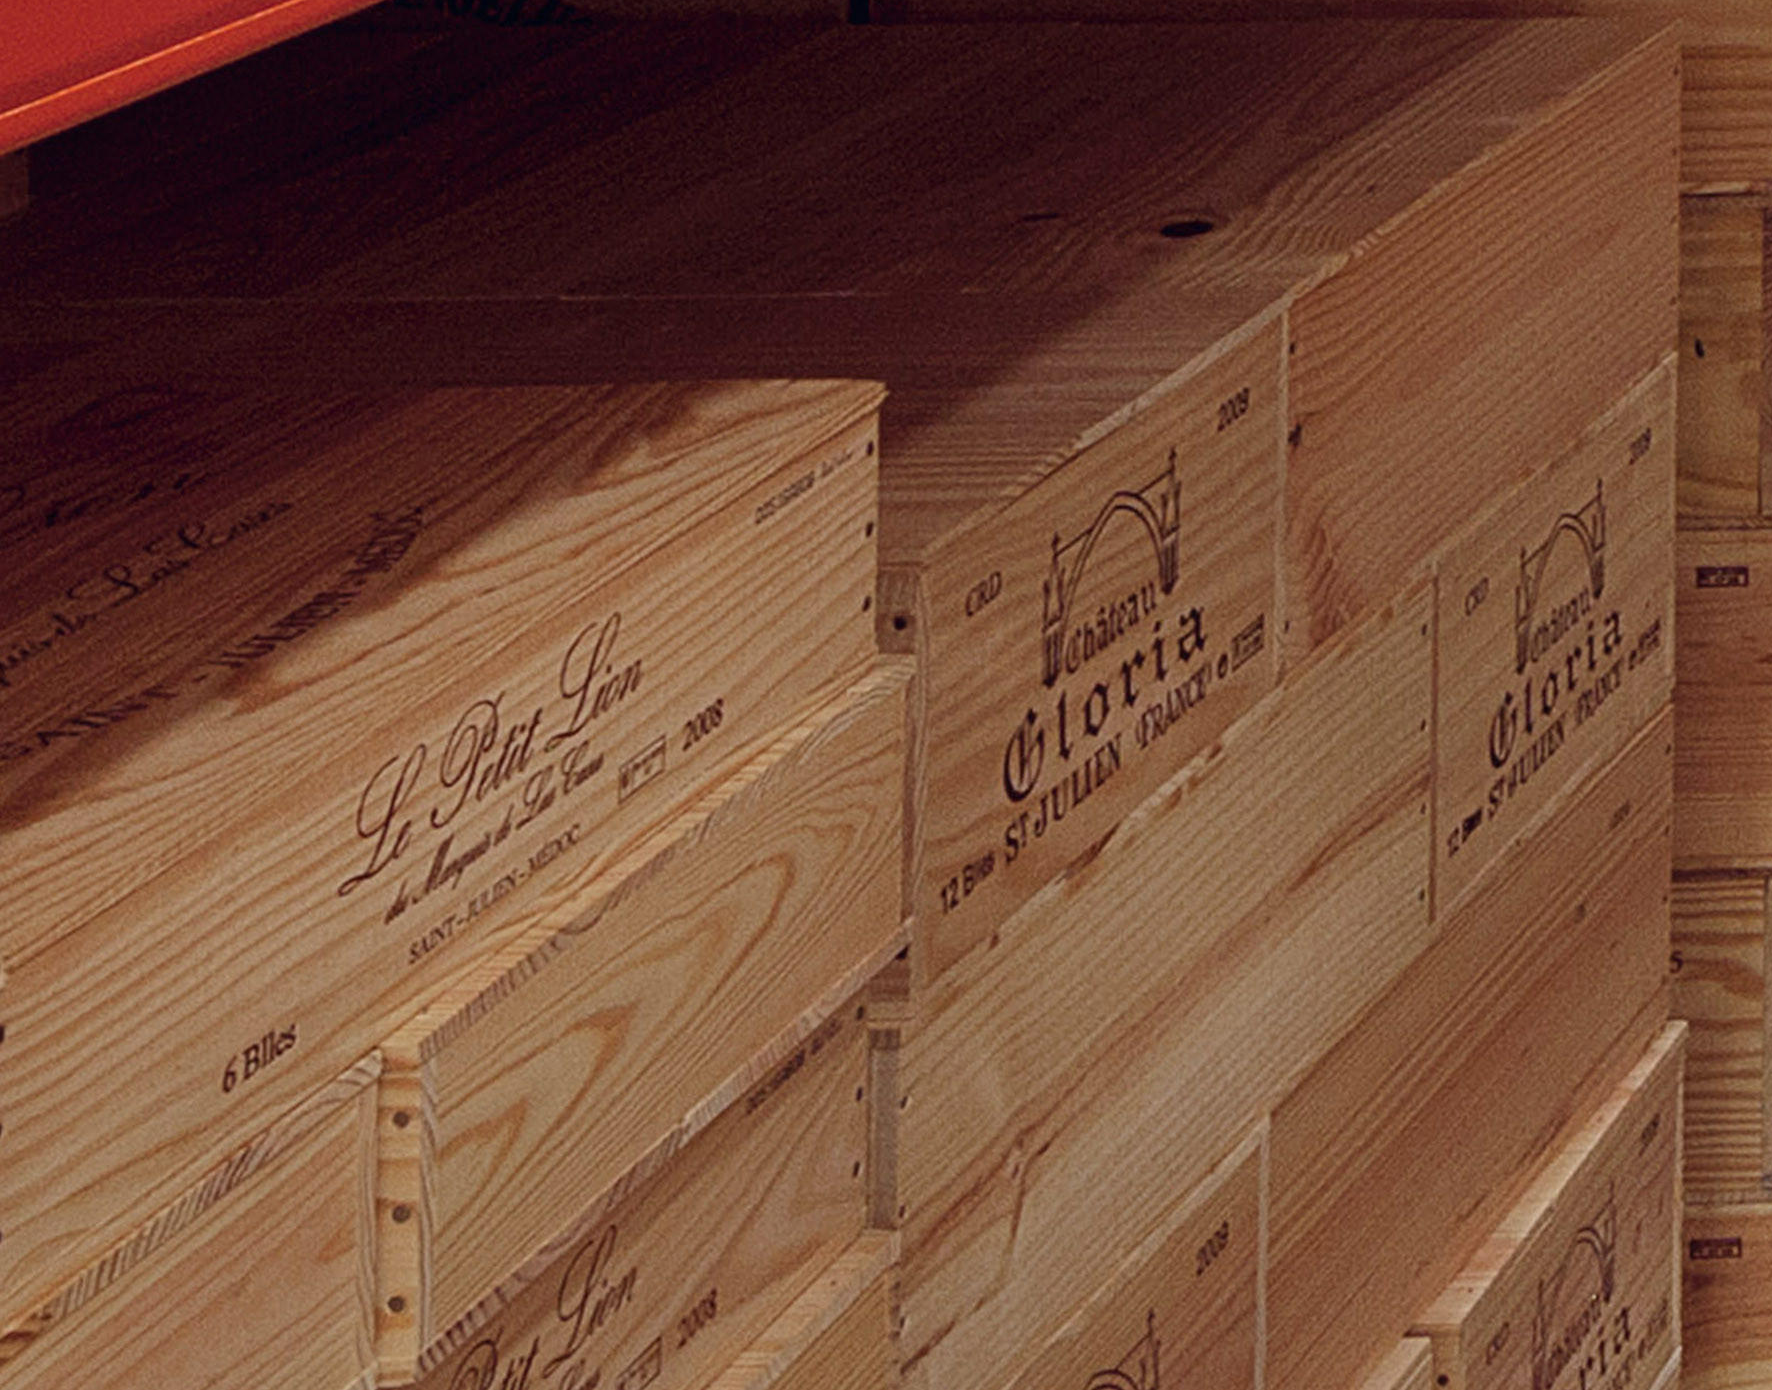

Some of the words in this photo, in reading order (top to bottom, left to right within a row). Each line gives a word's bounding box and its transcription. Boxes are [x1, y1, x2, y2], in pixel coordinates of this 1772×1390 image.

[965, 571, 1001, 618] CRD
[1066, 578, 1157, 673] Château
[1003, 606, 1208, 803] Gloria
[1488, 607, 1624, 772] Gloria
[338, 744, 426, 897] Le
[430, 689, 544, 829] Petit
[543, 611, 643, 753] Lion
[1036, 739, 1125, 839] JULIEN
[221, 1054, 240, 1095] 6
